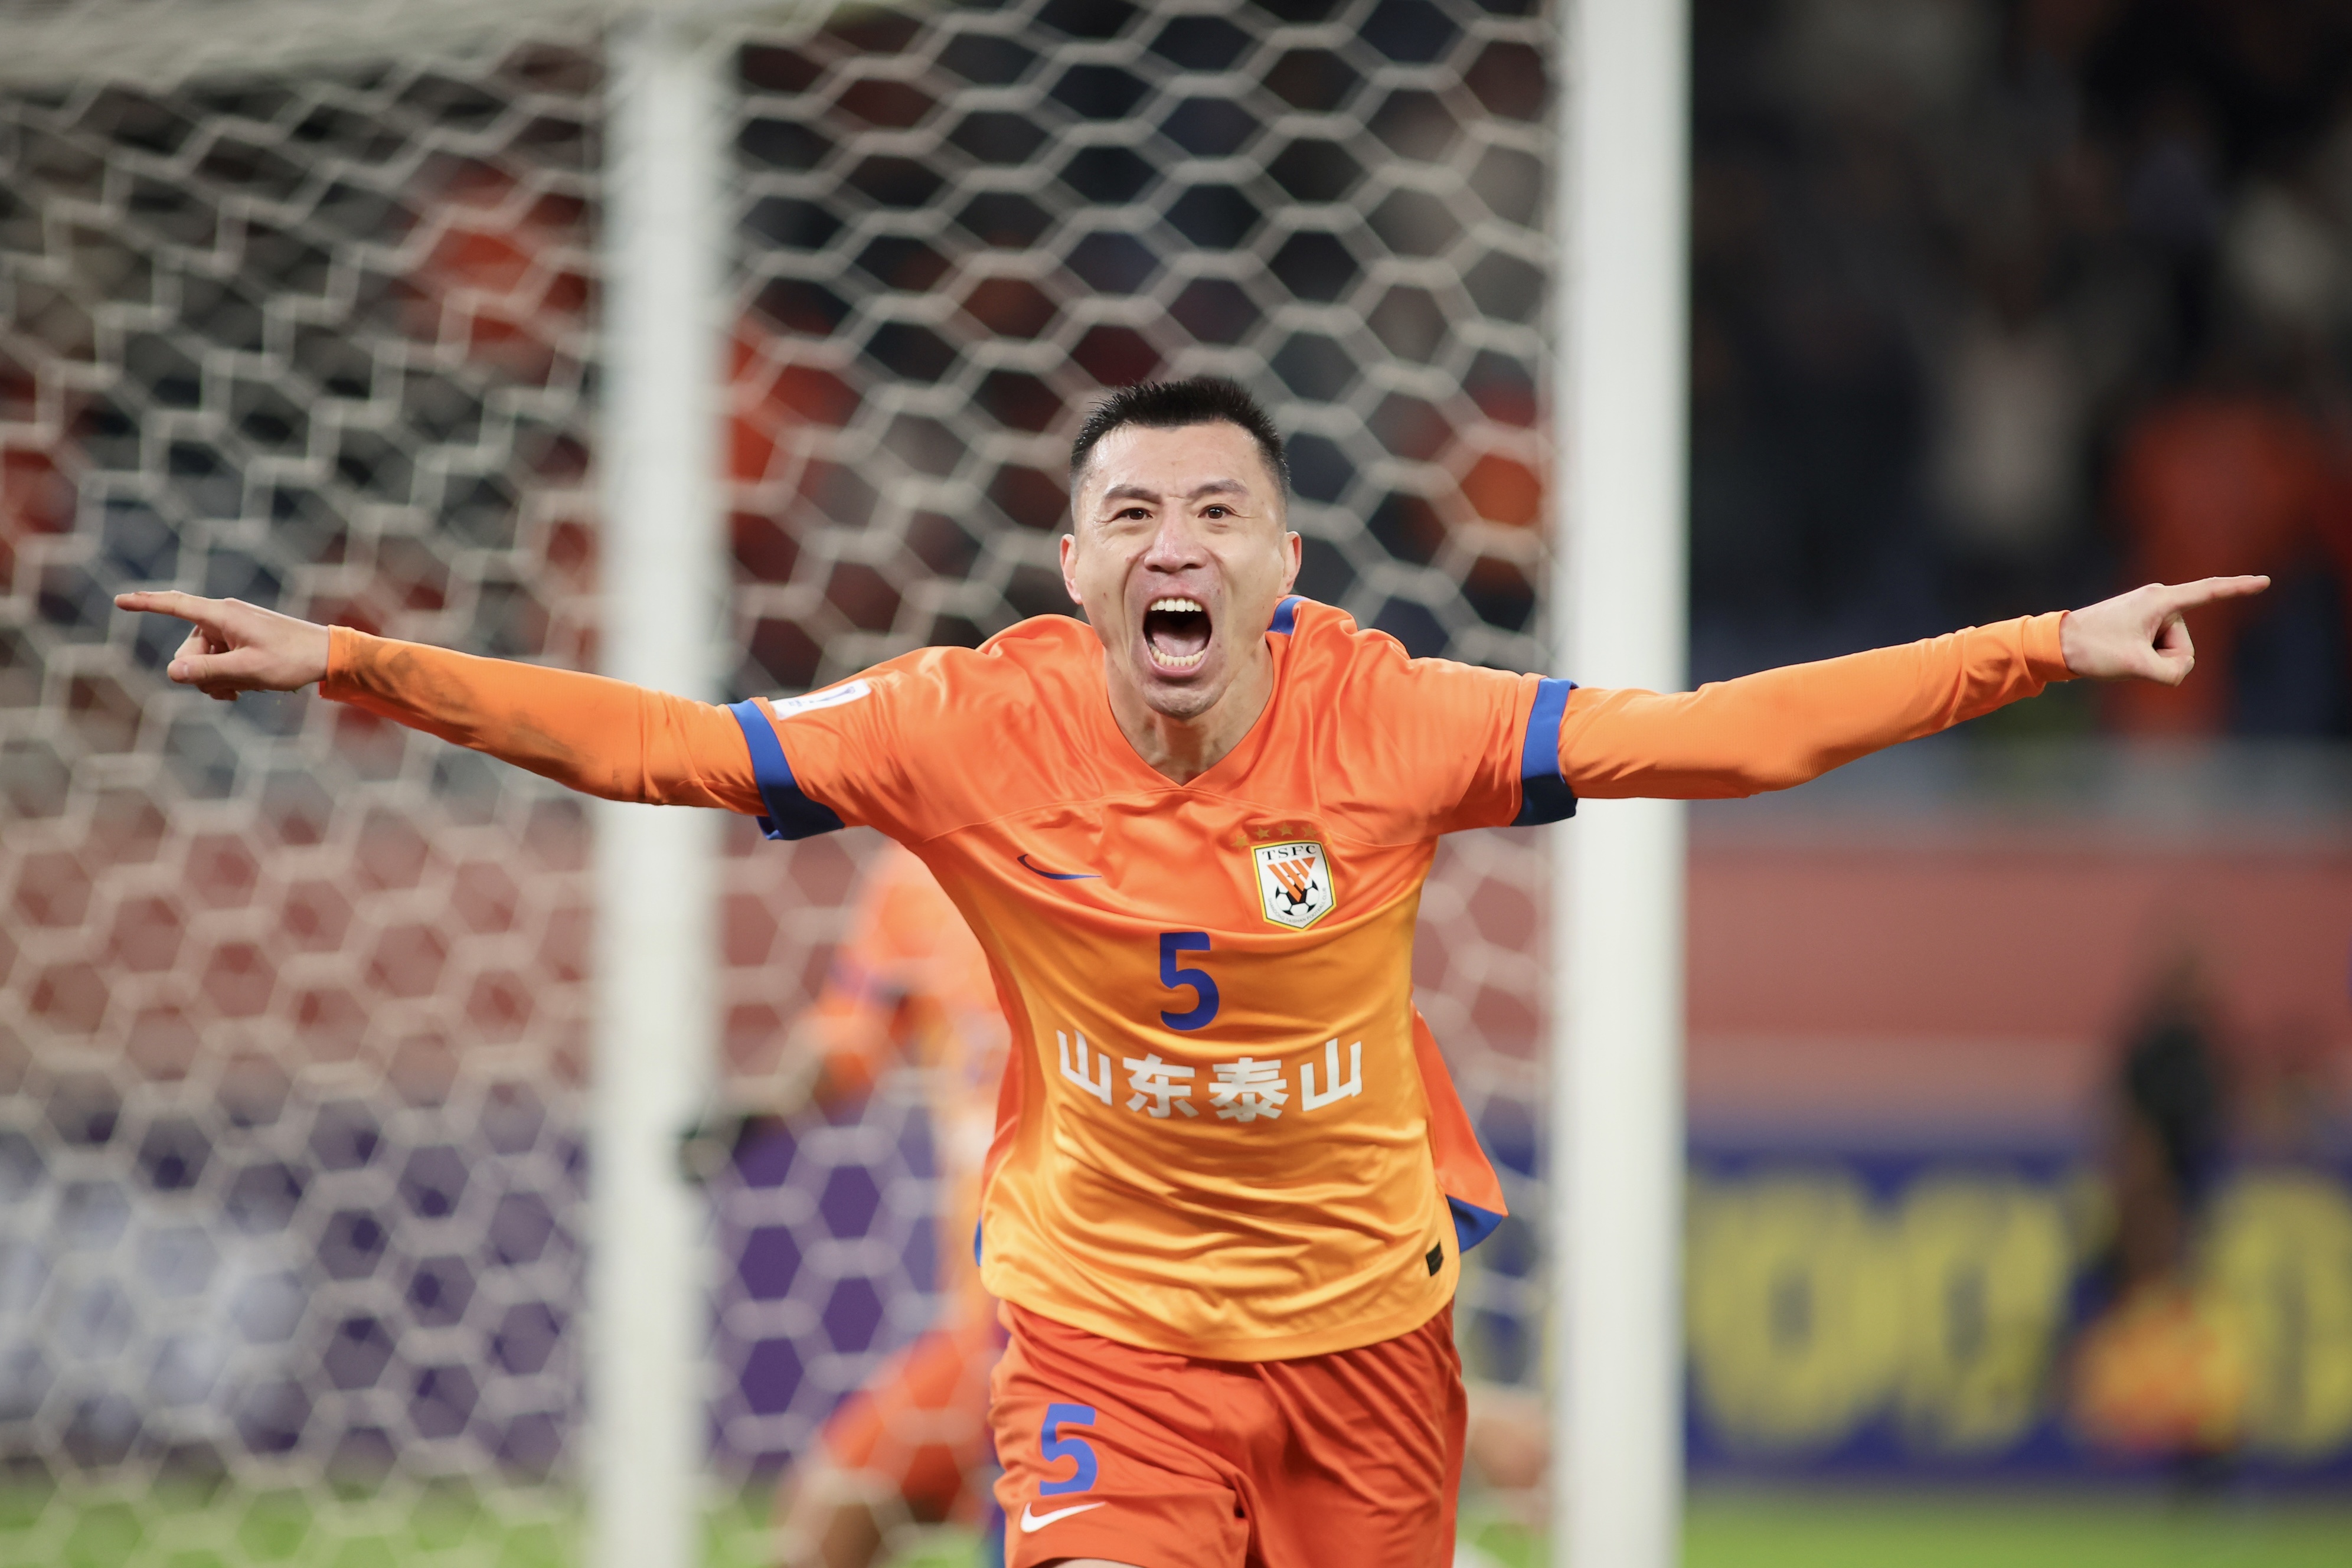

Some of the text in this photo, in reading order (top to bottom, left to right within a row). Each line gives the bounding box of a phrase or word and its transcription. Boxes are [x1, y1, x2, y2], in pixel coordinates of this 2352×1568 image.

[1262, 845, 1317, 861] TSFC
[1159, 931, 1219, 1031] 5
[1056, 1029, 1363, 1122] 山东泰山
[1039, 1402, 1098, 1497] 5
